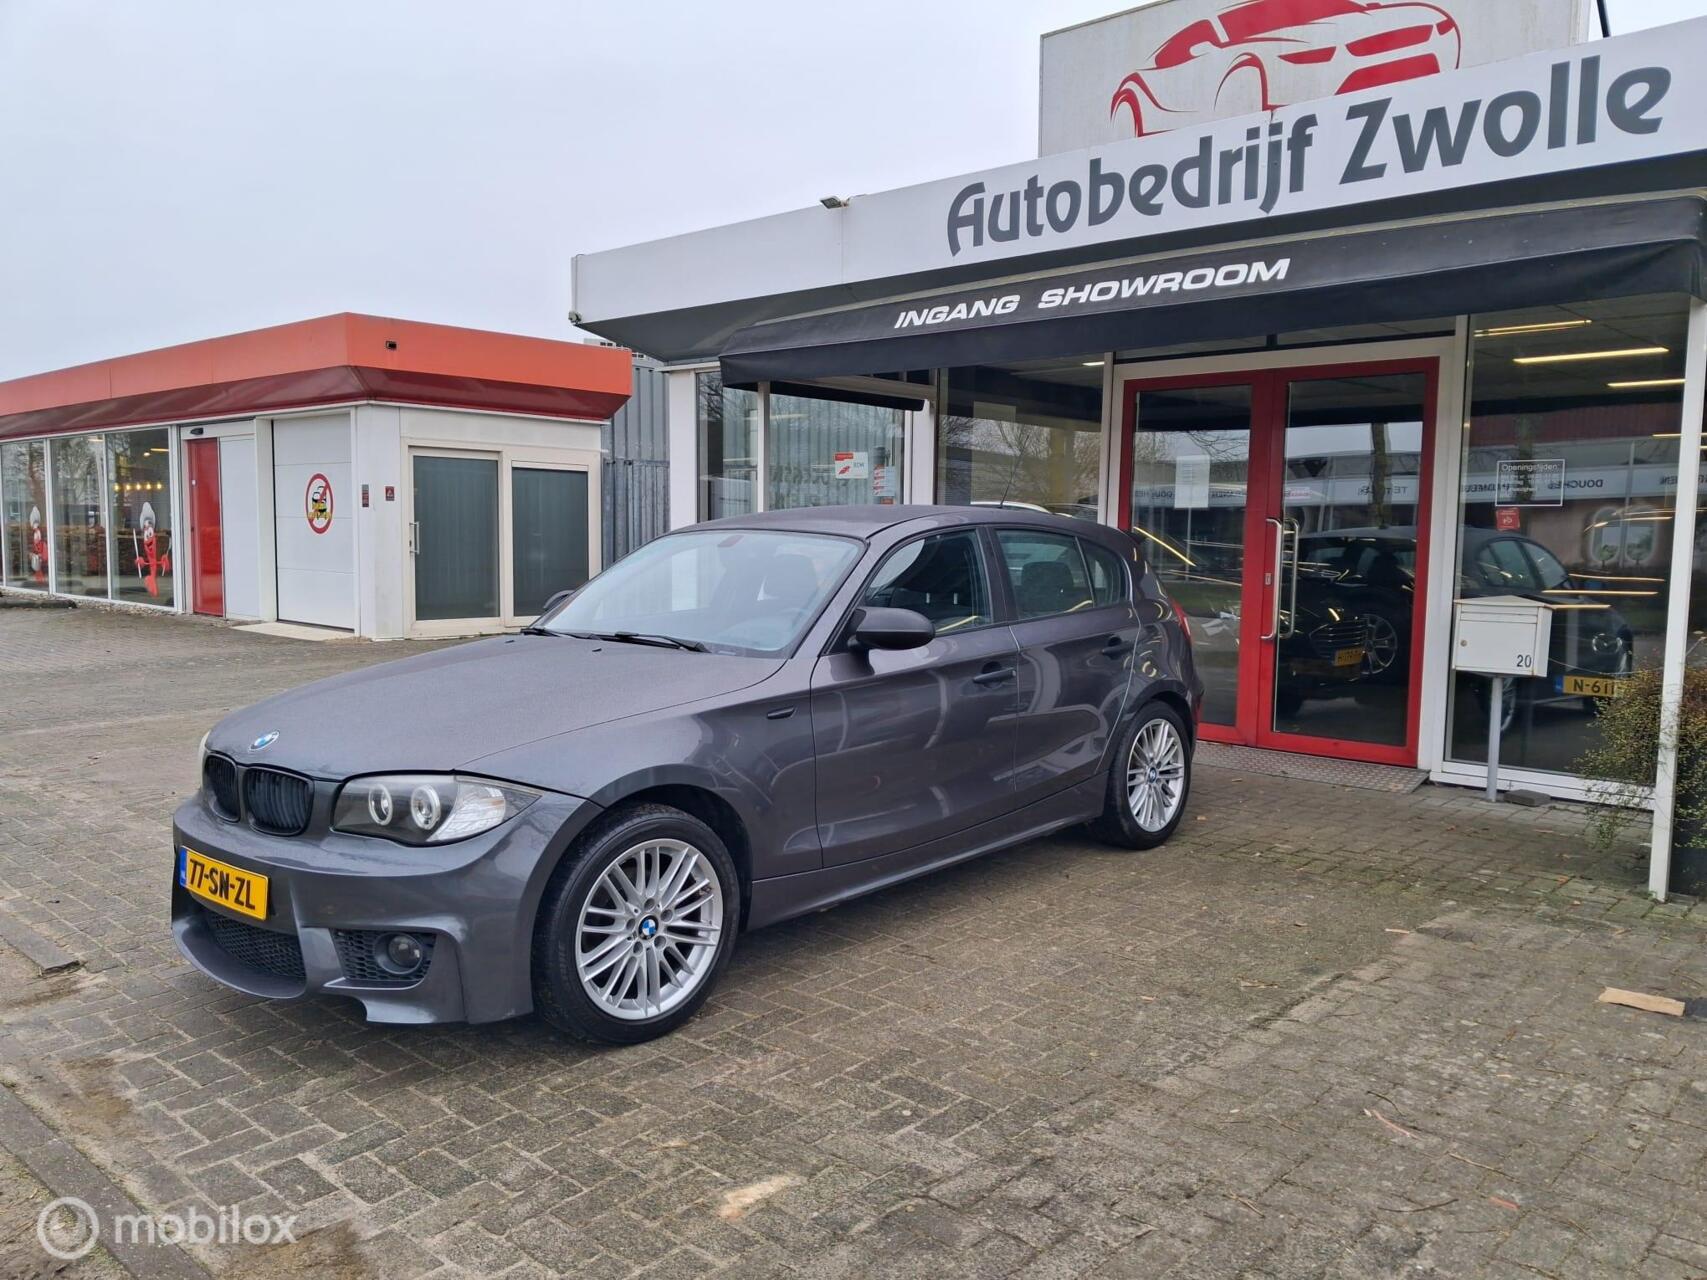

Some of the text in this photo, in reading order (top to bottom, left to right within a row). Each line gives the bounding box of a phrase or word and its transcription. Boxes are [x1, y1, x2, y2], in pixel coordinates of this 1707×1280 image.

[946, 54, 1672, 256] Autobedrijf Zwolle
[894, 258, 1291, 329] INGANG SHOWROOM
[1515, 653, 1532, 668] 20
[189, 858, 256, 911] 77-SN-ZL
